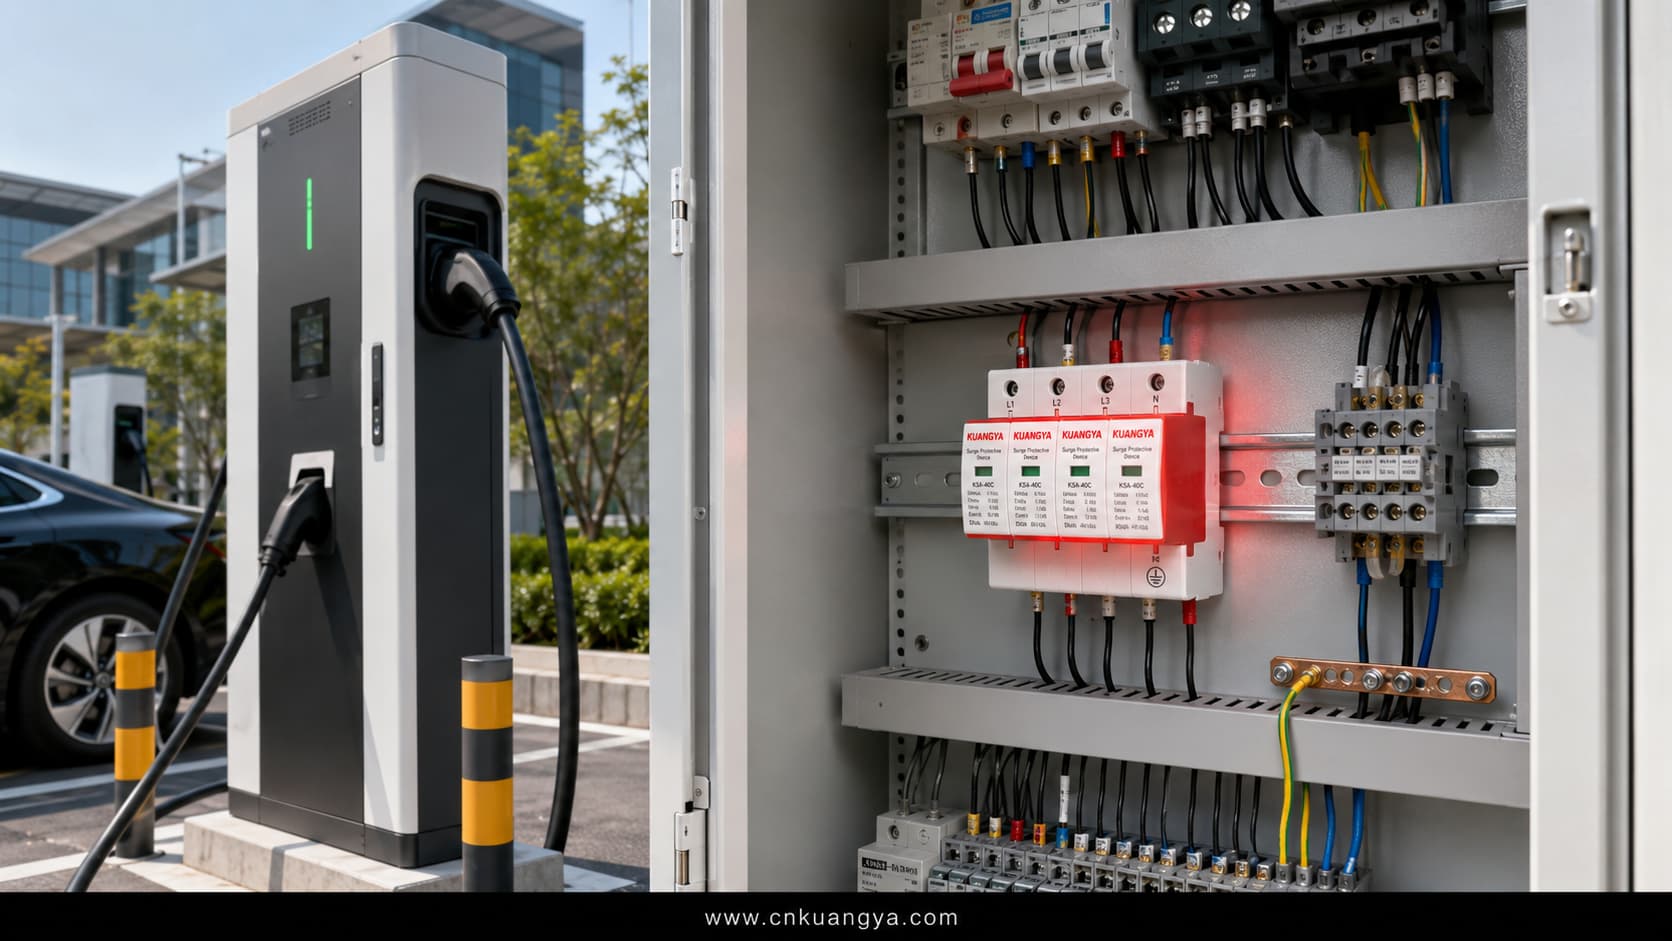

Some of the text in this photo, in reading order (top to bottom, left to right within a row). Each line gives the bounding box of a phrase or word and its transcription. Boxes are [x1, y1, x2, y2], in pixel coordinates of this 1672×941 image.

[1052, 399, 1061, 407] L2
[1100, 397, 1110, 405] L3
[1152, 395, 1159, 403] N
[967, 431, 1004, 441] KUANGYA
[1013, 431, 1052, 440] KUANGYA
[1062, 430, 1102, 439] KUANGYA
[1112, 429, 1154, 439] KUANGYA
